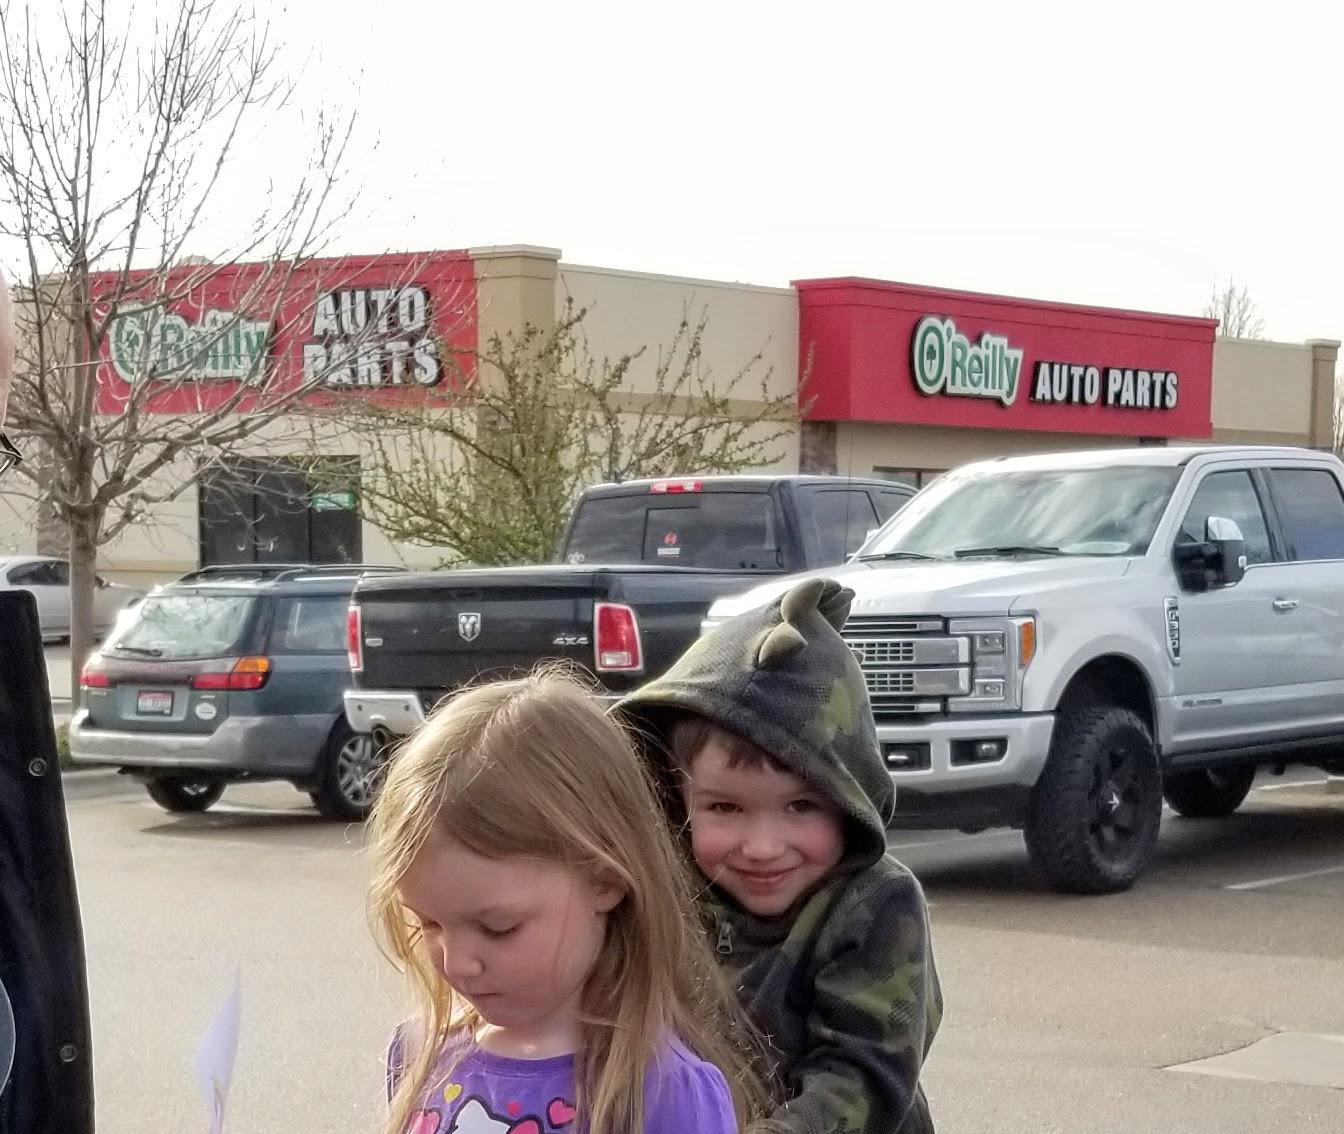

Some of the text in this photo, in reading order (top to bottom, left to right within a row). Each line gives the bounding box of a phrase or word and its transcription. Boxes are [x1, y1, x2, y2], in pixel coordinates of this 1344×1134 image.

[313, 287, 426, 336] AUTO
[303, 340, 439, 386] PARTS
[916, 320, 1177, 409] O'Reilly AUTO PARTS
